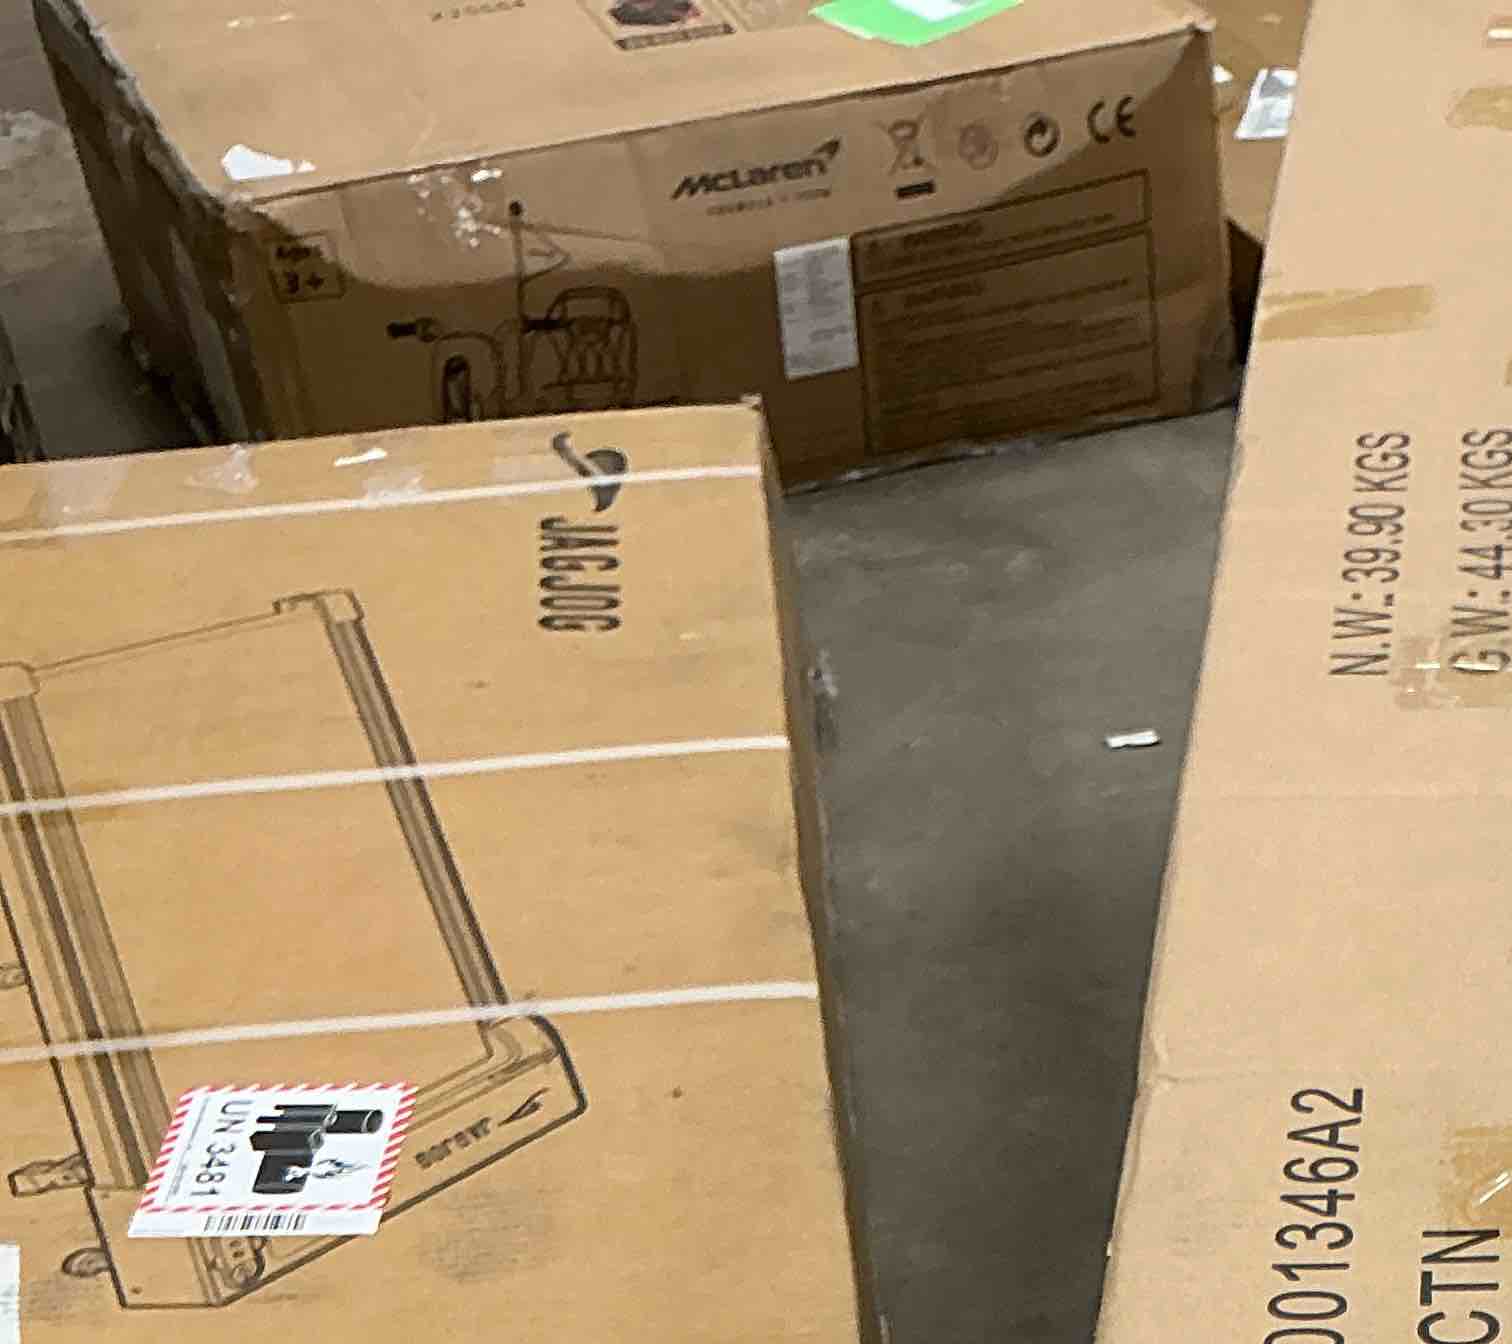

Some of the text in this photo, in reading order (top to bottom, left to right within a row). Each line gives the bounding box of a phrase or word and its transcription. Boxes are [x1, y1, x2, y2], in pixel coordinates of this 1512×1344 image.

[671, 146, 836, 200] McLaren
[1353, 432, 1411, 493] KGS
[538, 516, 623, 632] JAGJOG
[1342, 504, 1406, 584] 39.90
[190, 1099, 253, 1198] UN 3481
